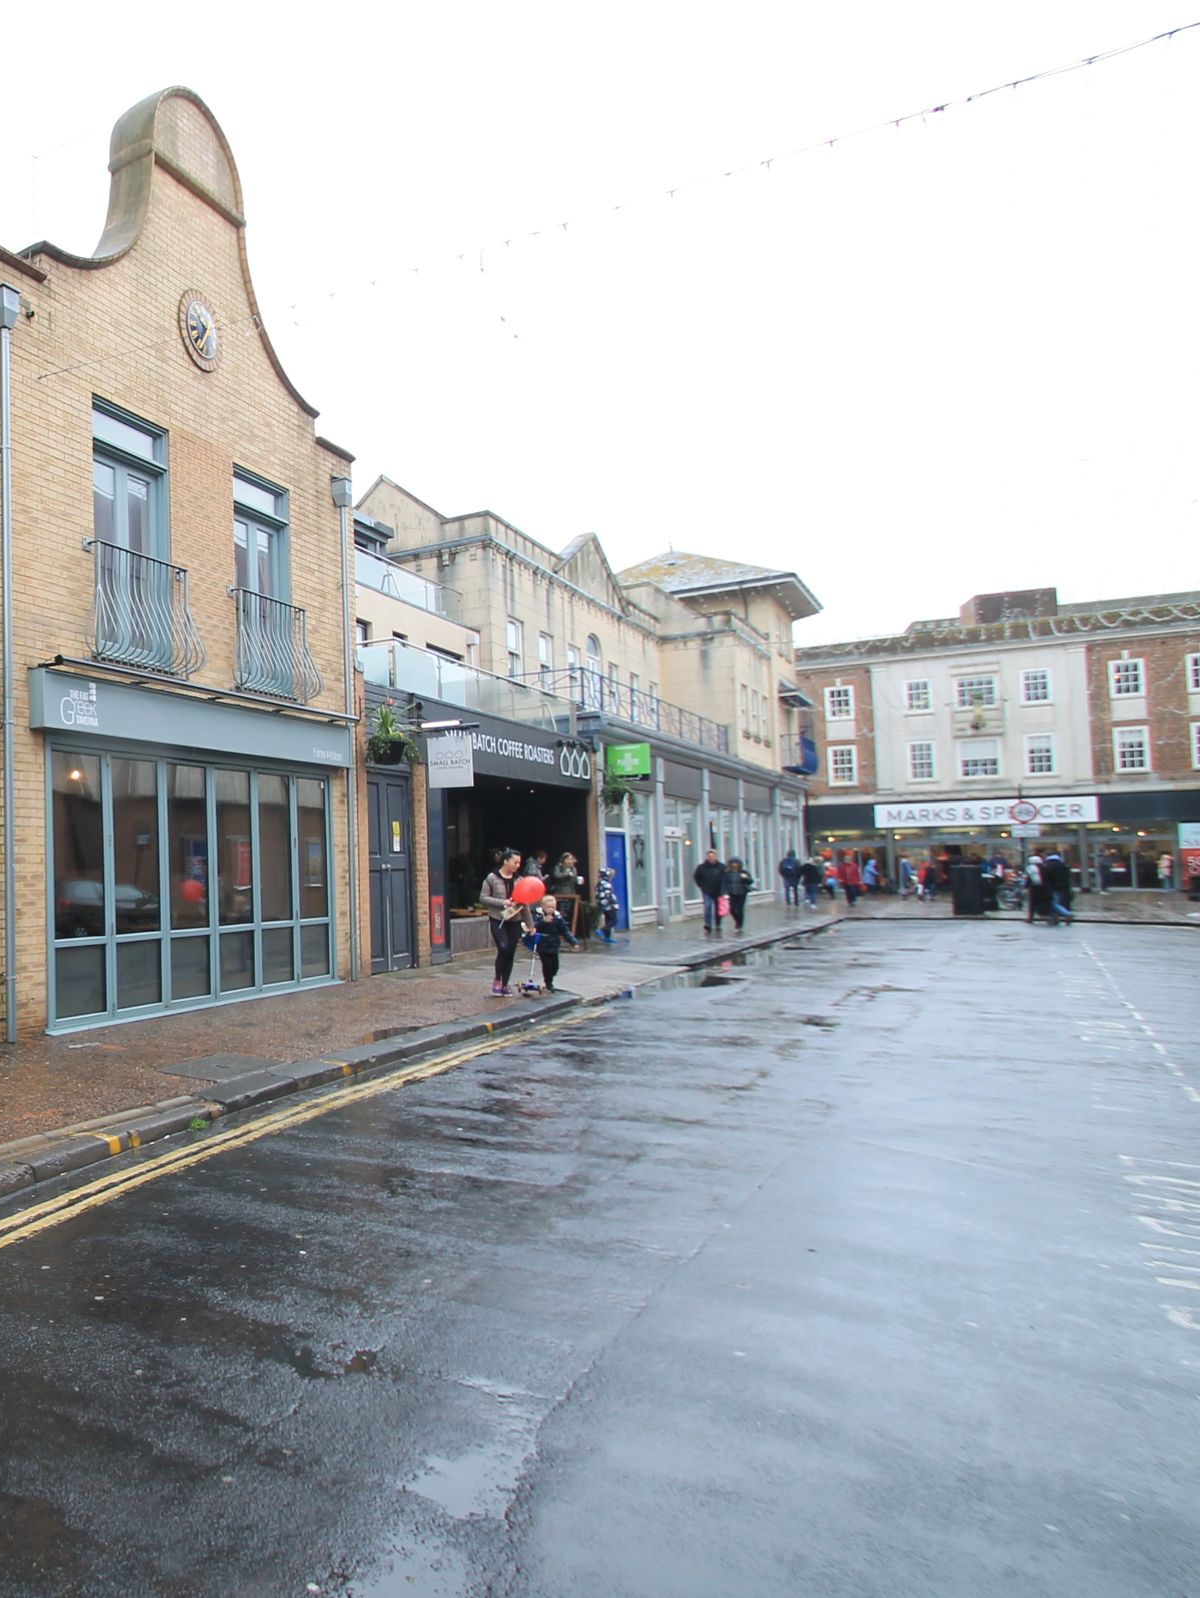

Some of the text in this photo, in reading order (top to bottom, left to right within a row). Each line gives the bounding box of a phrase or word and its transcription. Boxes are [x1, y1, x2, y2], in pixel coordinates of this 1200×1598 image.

[60, 697, 97, 725] Greek
[472, 732, 555, 765] BATCH COFFEE ROASTERS
[886, 803, 1084, 823] MARKS & SPECER
